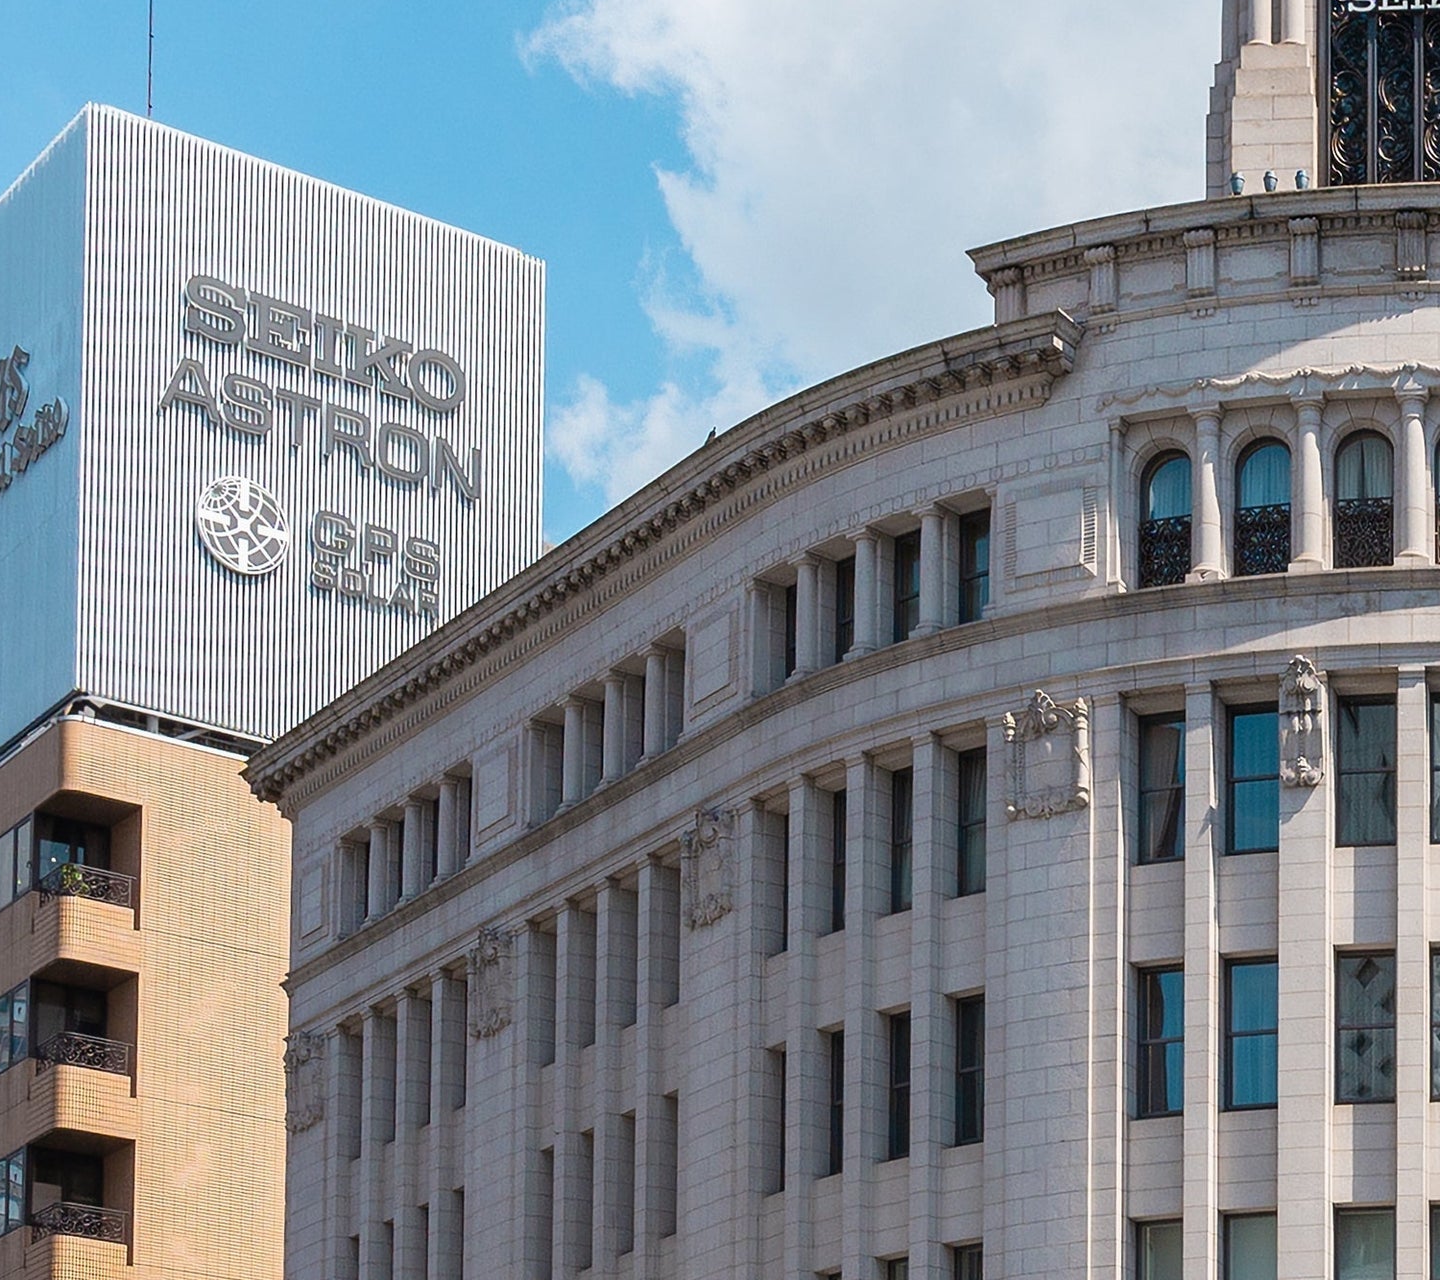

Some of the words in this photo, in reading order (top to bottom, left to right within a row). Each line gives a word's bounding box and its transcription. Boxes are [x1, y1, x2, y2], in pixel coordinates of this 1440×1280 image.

[184, 273, 467, 413] SEIKO
[159, 358, 482, 502] ASTRON
[311, 558, 440, 618] SOLAR
[312, 508, 441, 582] GPS
